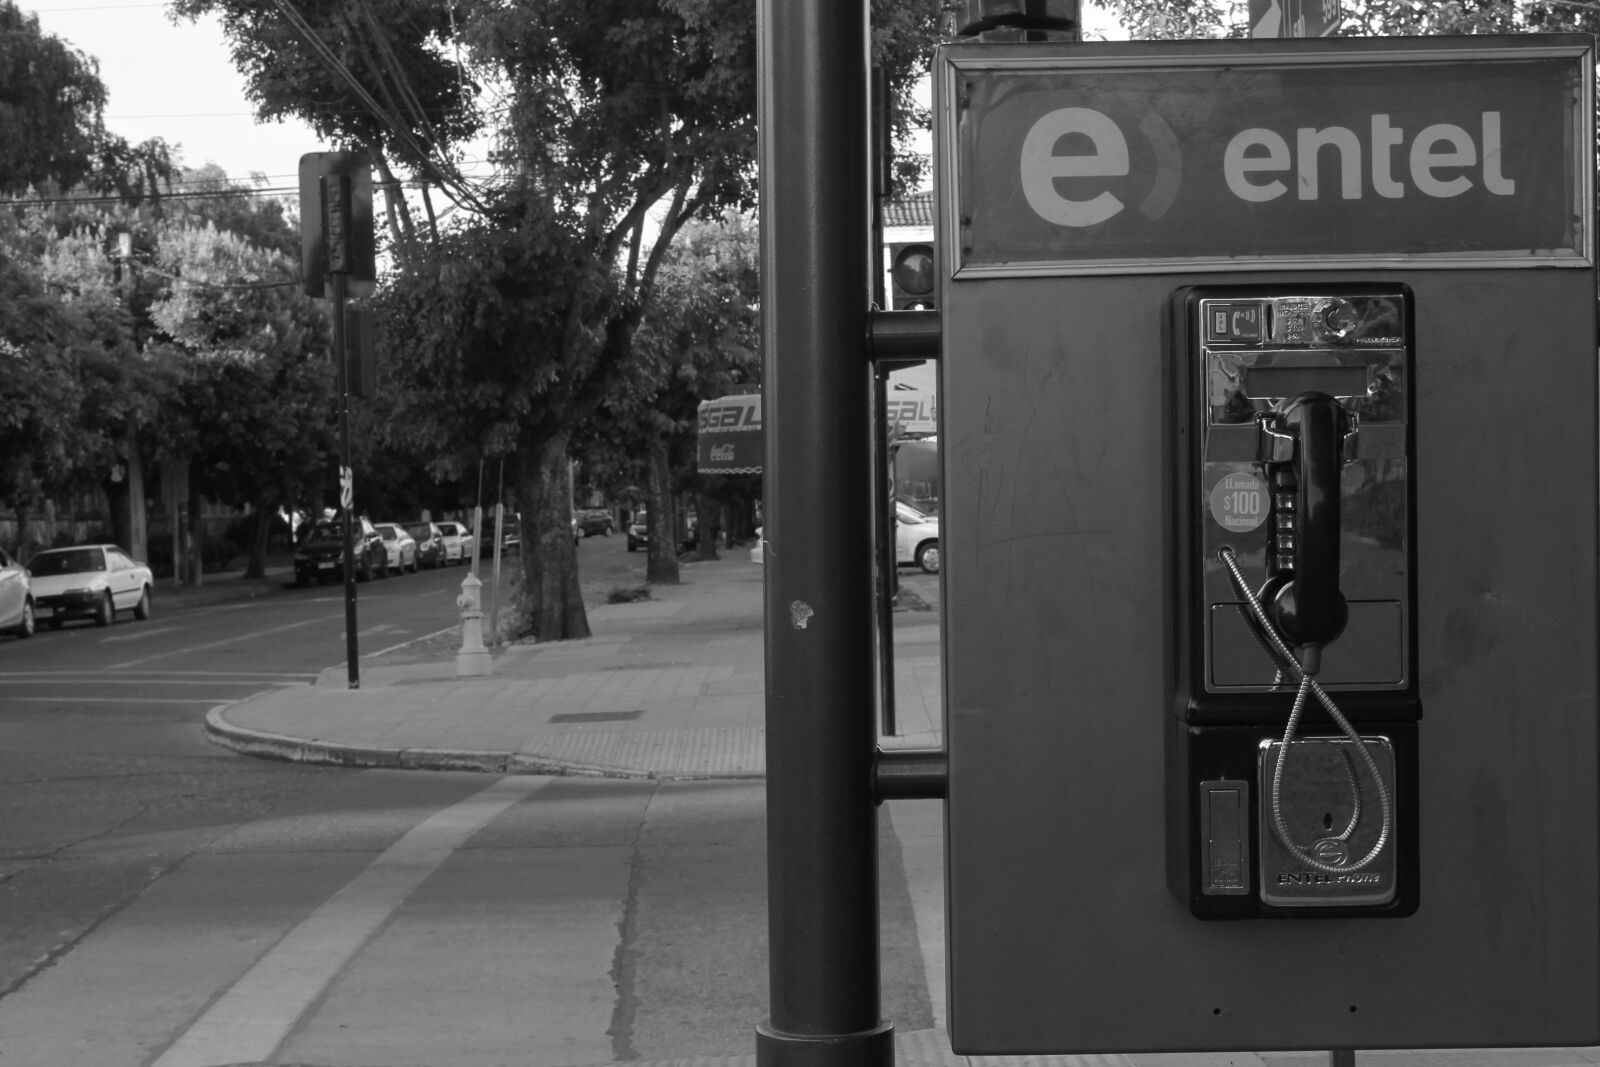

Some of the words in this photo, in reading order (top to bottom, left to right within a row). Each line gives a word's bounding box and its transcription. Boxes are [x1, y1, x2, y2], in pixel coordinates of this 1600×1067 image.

[1223, 110, 1516, 202] entel
[1223, 491, 1260, 515] $100
[1277, 872, 1334, 886] ENTEL
